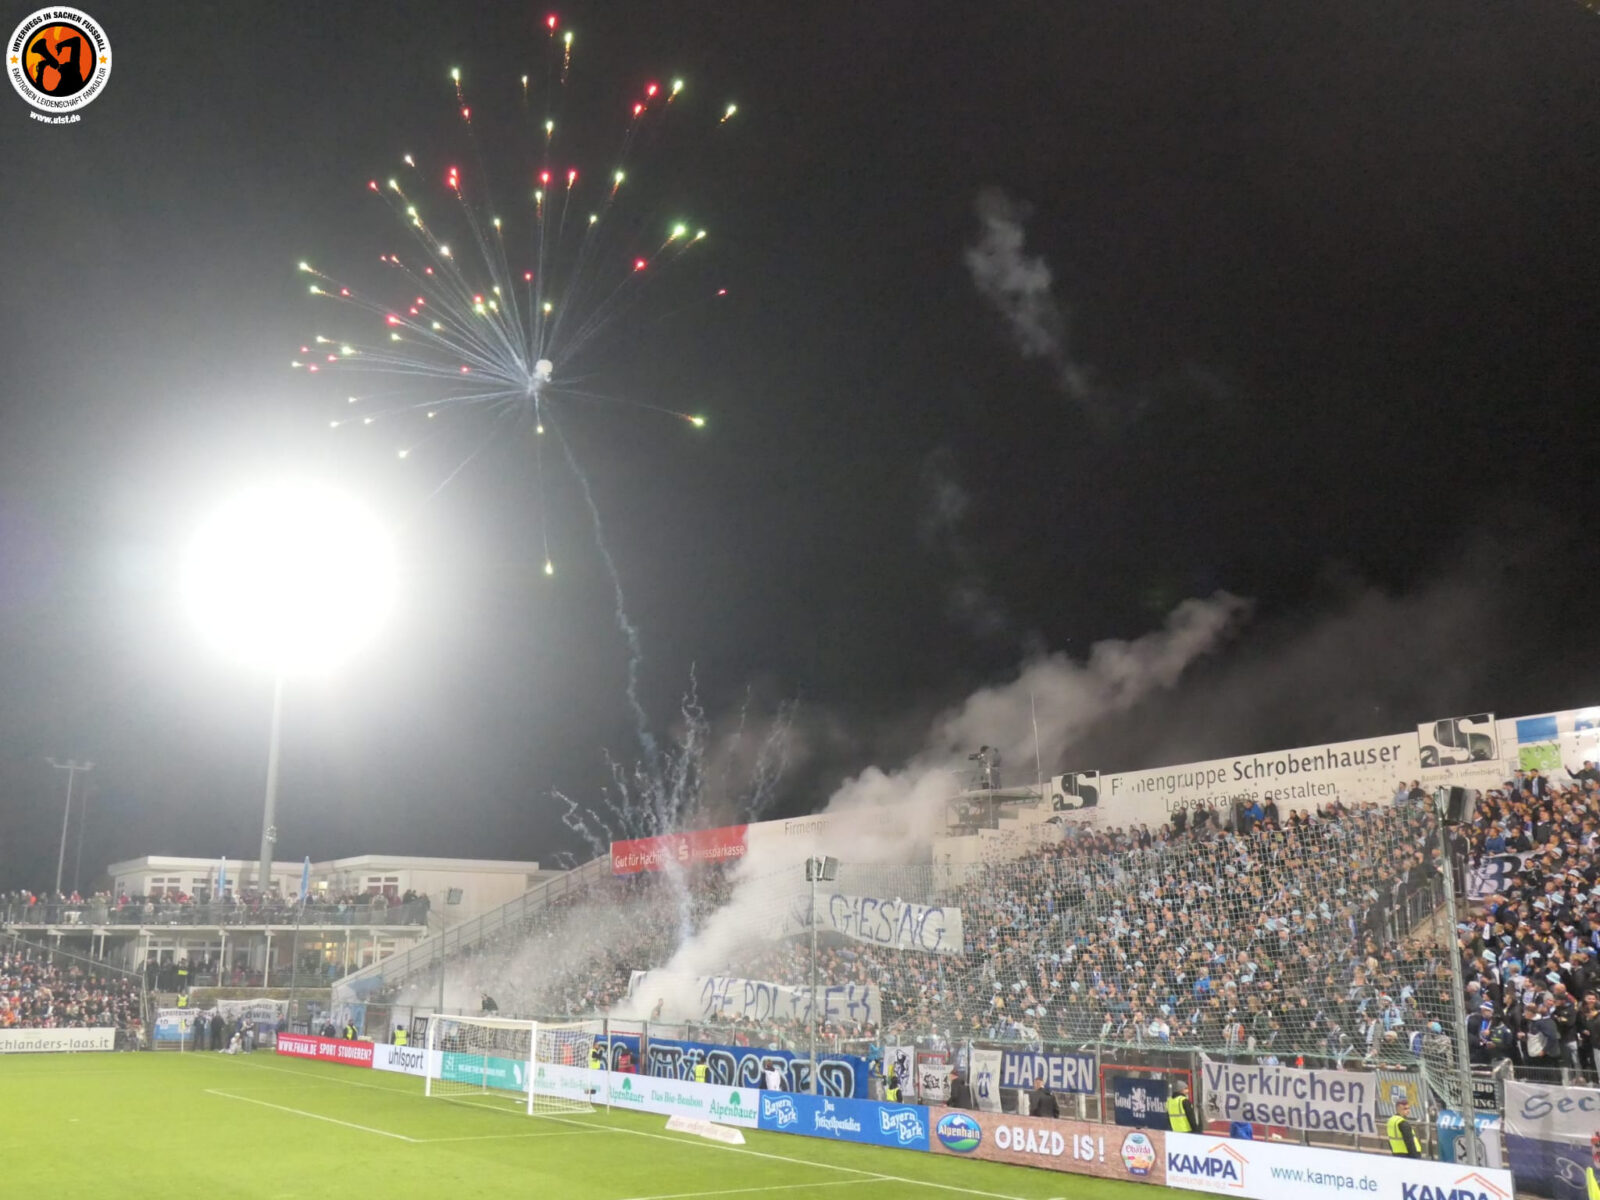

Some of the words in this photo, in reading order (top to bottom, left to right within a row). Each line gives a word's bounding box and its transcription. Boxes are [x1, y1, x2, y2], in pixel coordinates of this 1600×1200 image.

[1232, 743, 1401, 781] Schrobenhauser
[1264, 781, 1337, 803] gestalten
[615, 855, 627, 869] Gut
[628, 851, 639, 866] für
[319, 1043, 336, 1056] SPORT
[337, 1046, 372, 1061] STUDIEREN?
[388, 1048, 424, 1071] uhlsport
[1004, 1053, 1095, 1091] HADERN
[1204, 1062, 1365, 1104] Vierkirchen
[651, 1090, 663, 1101] Das
[824, 1099, 835, 1113] Das
[1519, 1092, 1600, 1120] Sec
[709, 1098, 758, 1120] Alpenbauer
[764, 1098, 793, 1116] Bayern
[778, 1109, 798, 1125] Park
[1225, 1093, 1374, 1133] Pasenbach
[881, 1110, 916, 1131] Bayern
[900, 1121, 924, 1141] Park
[937, 1124, 981, 1141] Alpenhain
[994, 1124, 1065, 1156] OBAZD
[1073, 1133, 1105, 1162] IS!
[1167, 1151, 1238, 1180] KAMPA
[1270, 1165, 1378, 1192] www.kampa.de
